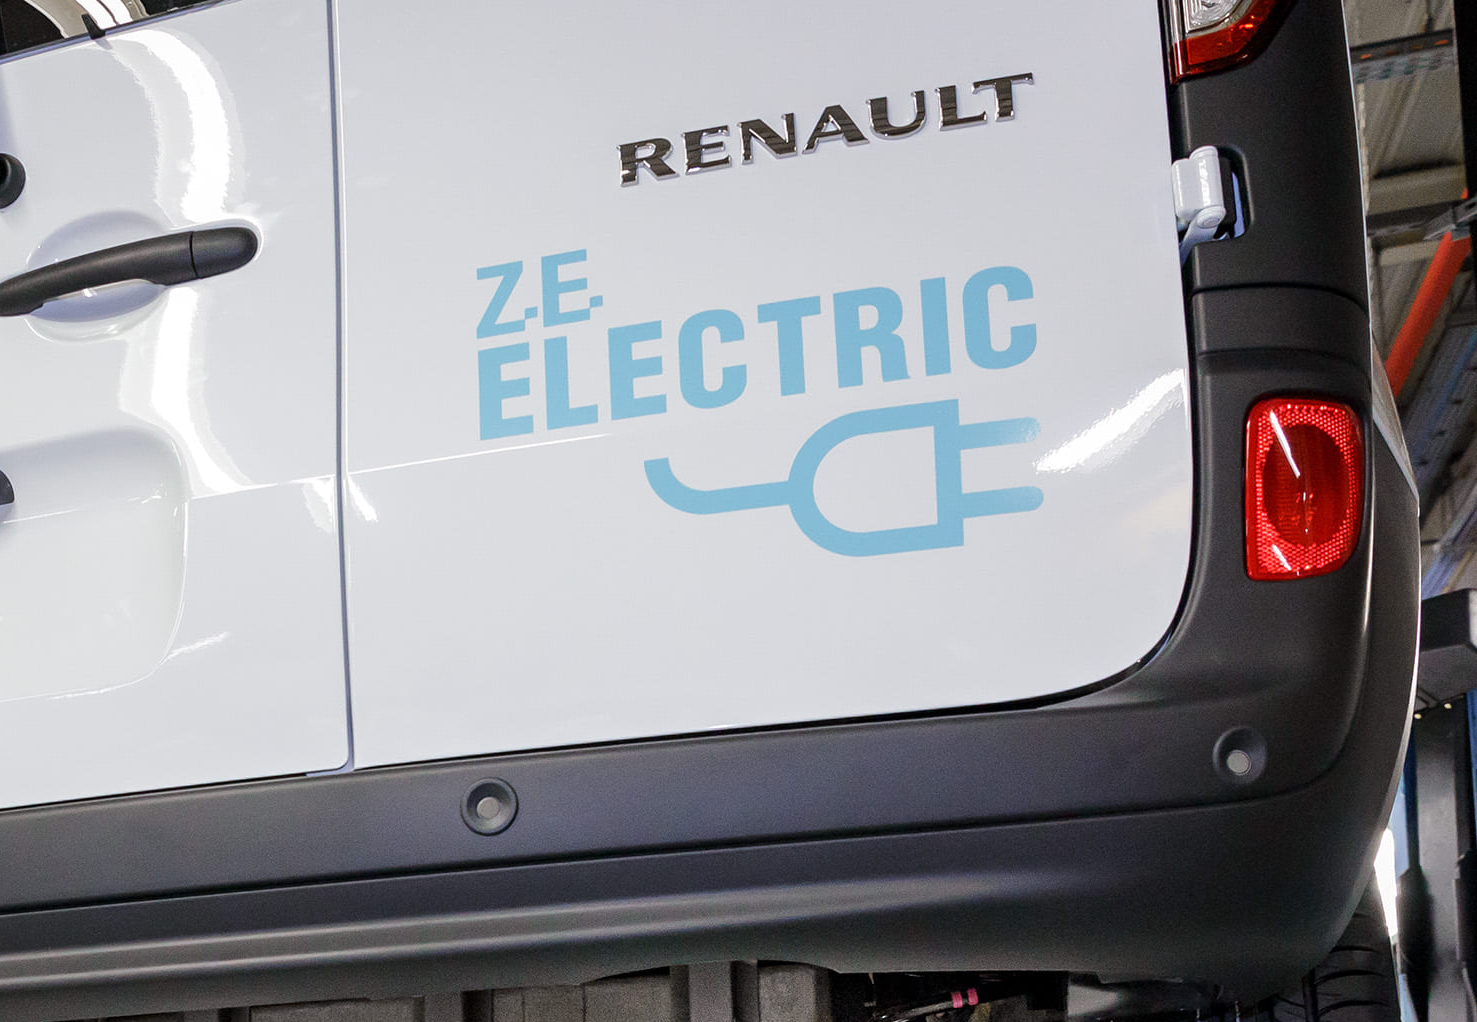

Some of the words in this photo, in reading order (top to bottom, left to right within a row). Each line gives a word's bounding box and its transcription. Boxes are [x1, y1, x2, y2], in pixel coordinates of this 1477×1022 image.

[616, 72, 1035, 188] RENAULT
[476, 248, 604, 339] Z.E.
[477, 265, 1038, 441] ELECTRIC
